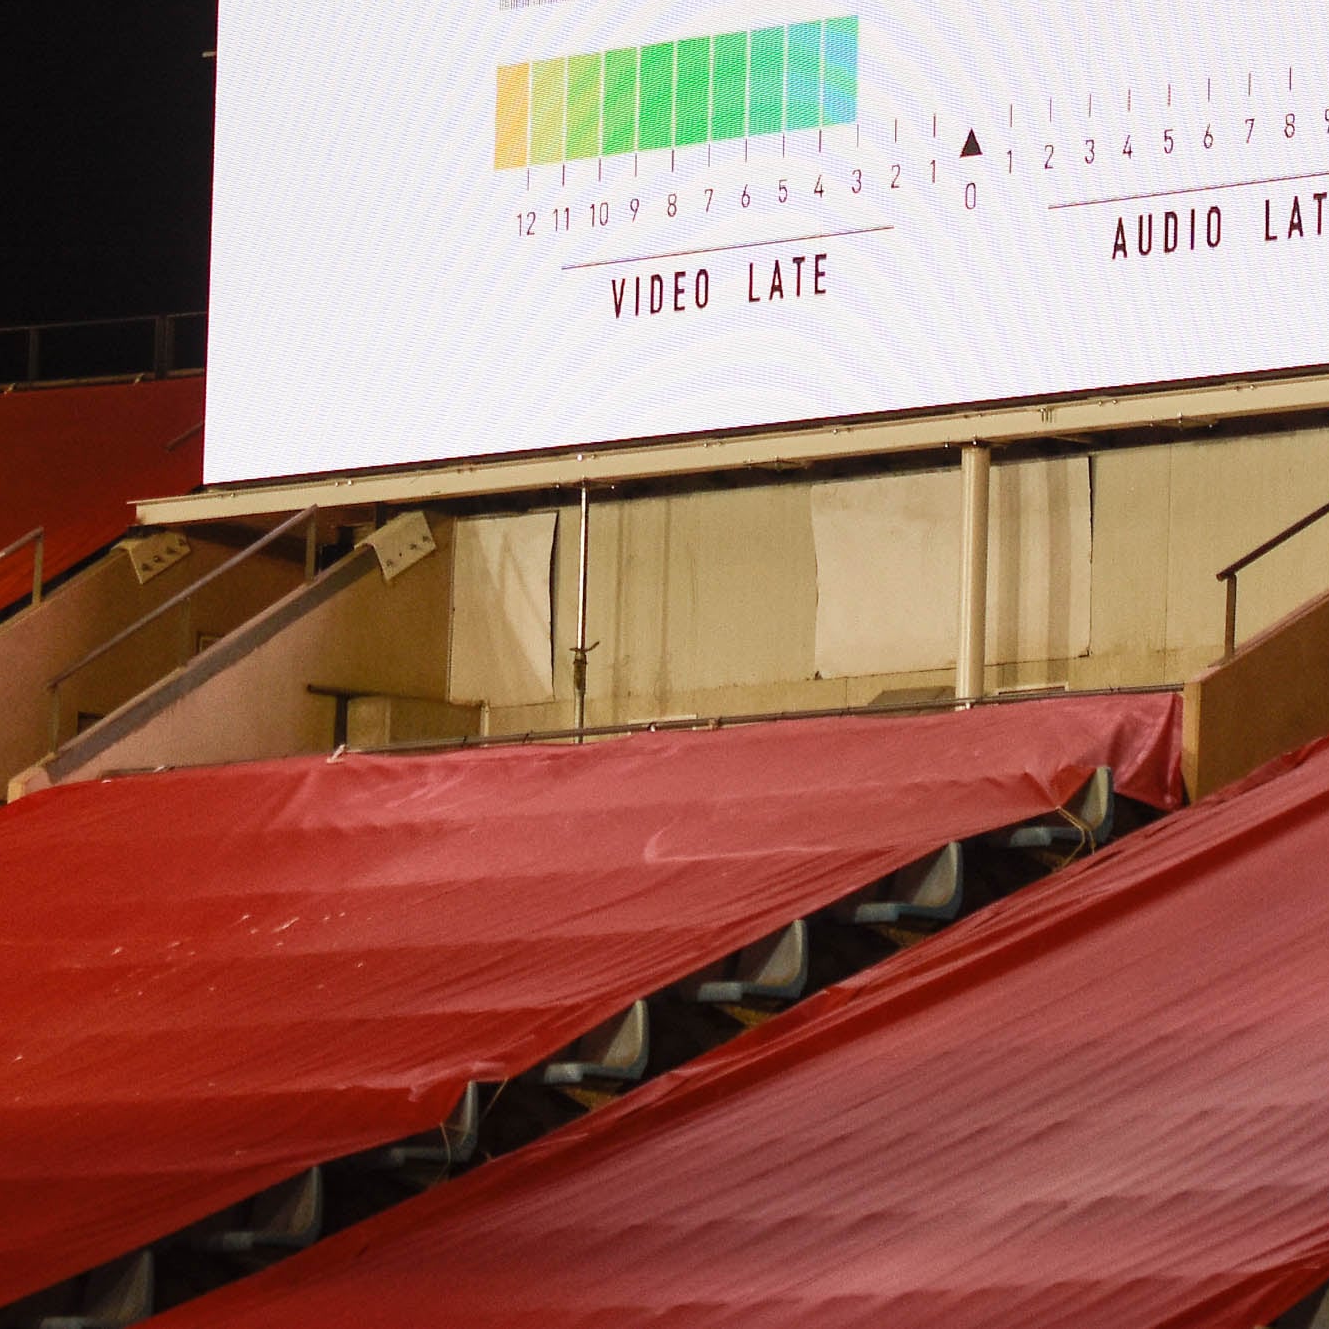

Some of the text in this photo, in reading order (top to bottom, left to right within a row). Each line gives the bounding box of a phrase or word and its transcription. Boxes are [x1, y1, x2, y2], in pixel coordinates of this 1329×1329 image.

[1043, 144, 1055, 170] 2
[1084, 139, 1095, 165] 3
[1122, 134, 1133, 159] 4
[1163, 128, 1174, 155] 5
[1202, 124, 1214, 150] 6
[1244, 117, 1255, 144] 7
[1283, 112, 1296, 139] 8
[517, 211, 537, 237] 12
[553, 207, 571, 231] 11
[589, 202, 610, 227] 10
[629, 198, 640, 222] 9
[666, 193, 678, 218] 8
[704, 188, 714, 213] 7
[740, 184, 751, 209] 6
[777, 179, 789, 204] 5
[813, 174, 825, 199] 4
[851, 169, 862, 194] 3
[890, 164, 901, 190] 2
[964, 181, 977, 210] 0
[1111, 205, 1222, 261] AUDIO
[610, 252, 828, 319] VIDEO LATE
